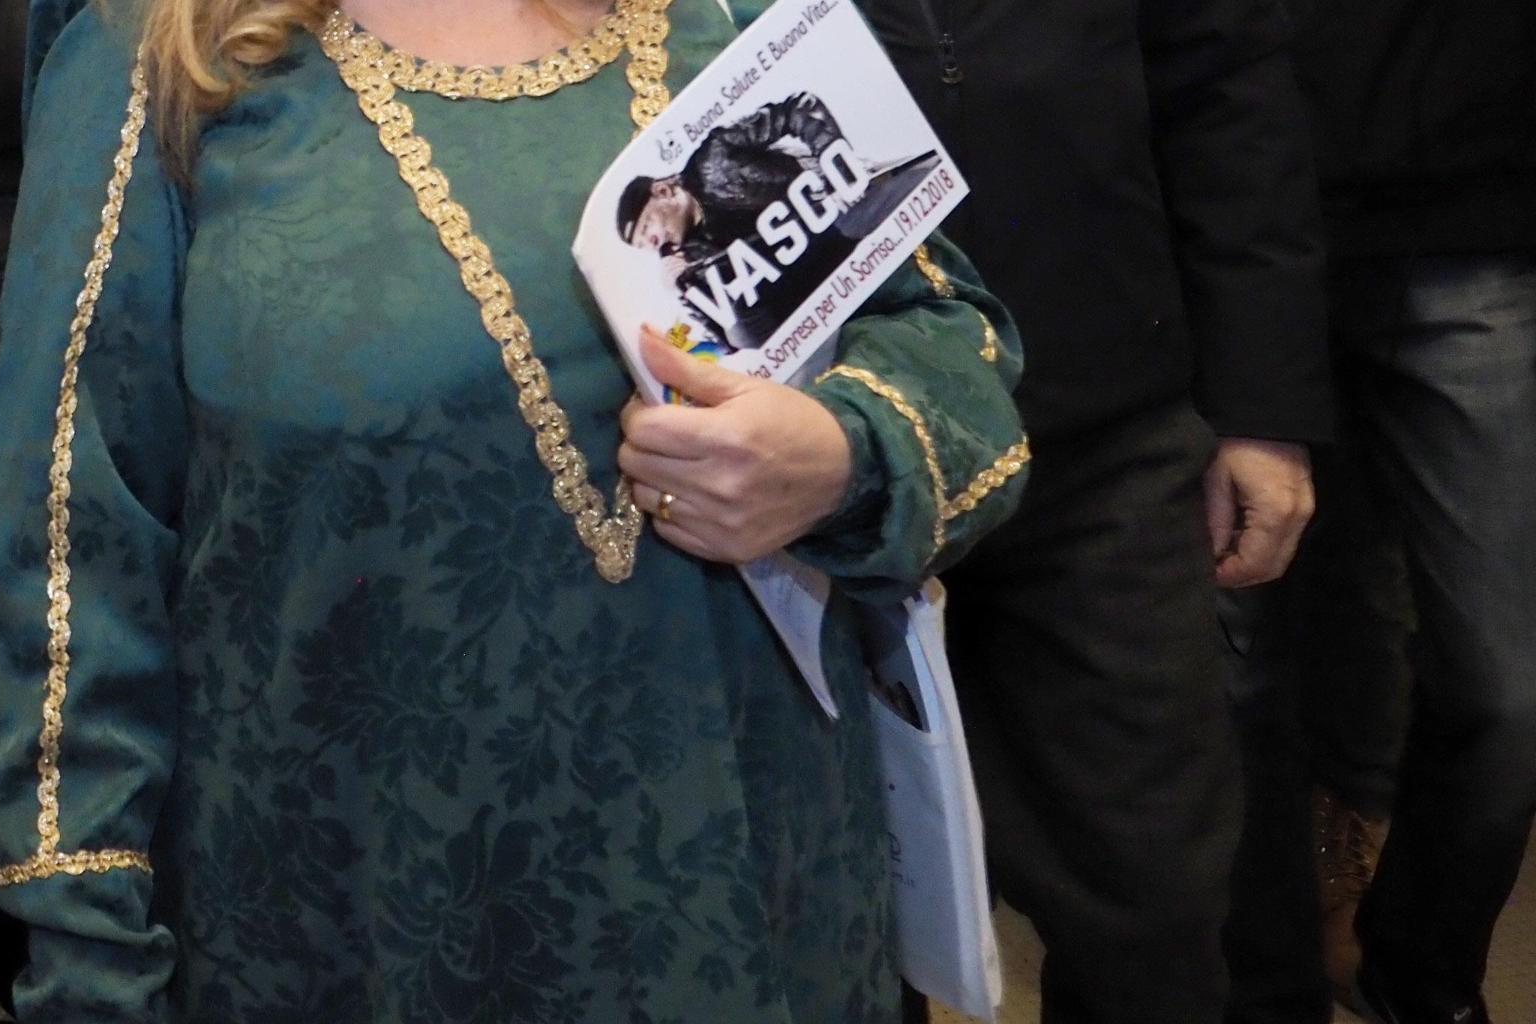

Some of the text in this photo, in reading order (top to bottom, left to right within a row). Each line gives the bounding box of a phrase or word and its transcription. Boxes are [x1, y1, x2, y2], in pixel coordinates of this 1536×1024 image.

[683, 102, 724, 143] Buona
[720, 67, 761, 107] Salute
[756, 50, 773, 72] E
[767, 21, 808, 62] Buona
[684, 138, 870, 329] VASCO
[745, 363, 773, 380] na
[764, 314, 819, 370] Sorpresa
[814, 293, 838, 328] per
[830, 275, 857, 299] Un
